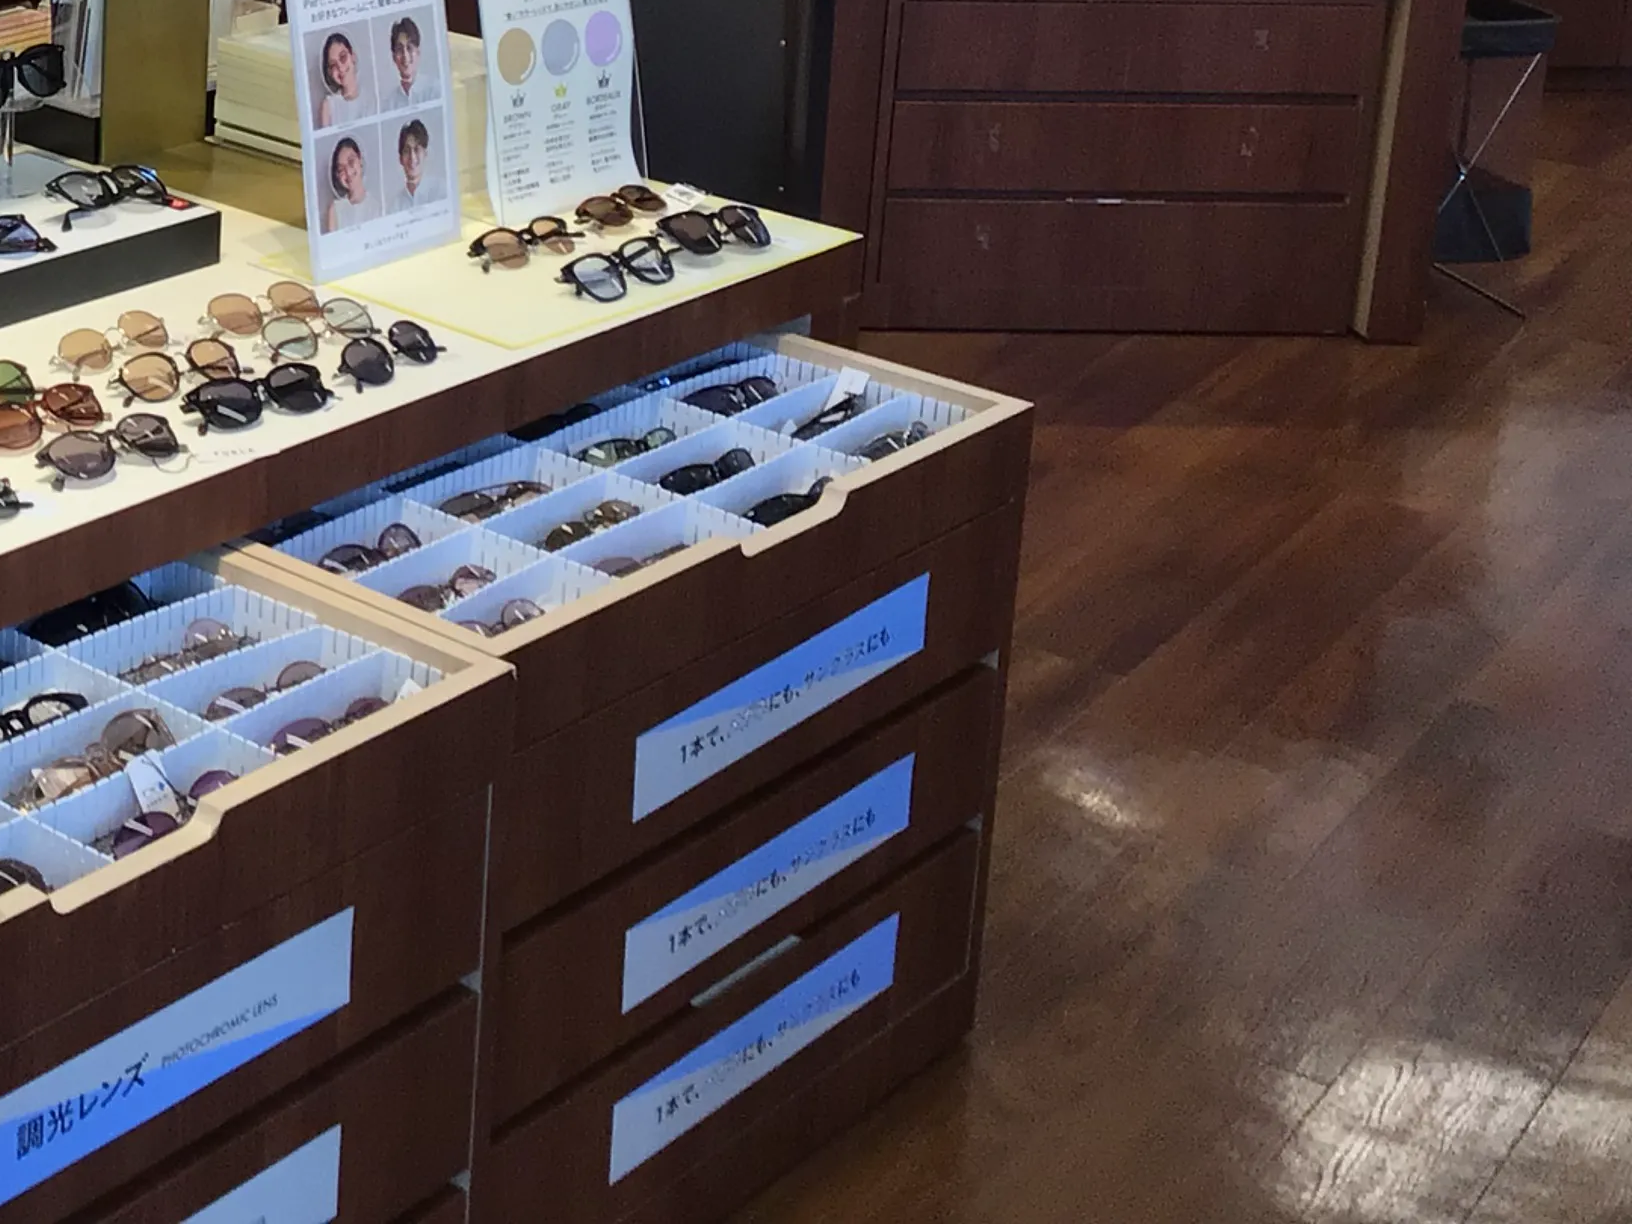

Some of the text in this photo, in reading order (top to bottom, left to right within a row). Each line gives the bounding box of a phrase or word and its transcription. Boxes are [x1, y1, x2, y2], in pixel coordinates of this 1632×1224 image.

[160, 993, 279, 1069] PHOTOCHROMIC LENS
[16, 1051, 150, 1162] 調光レンズ
